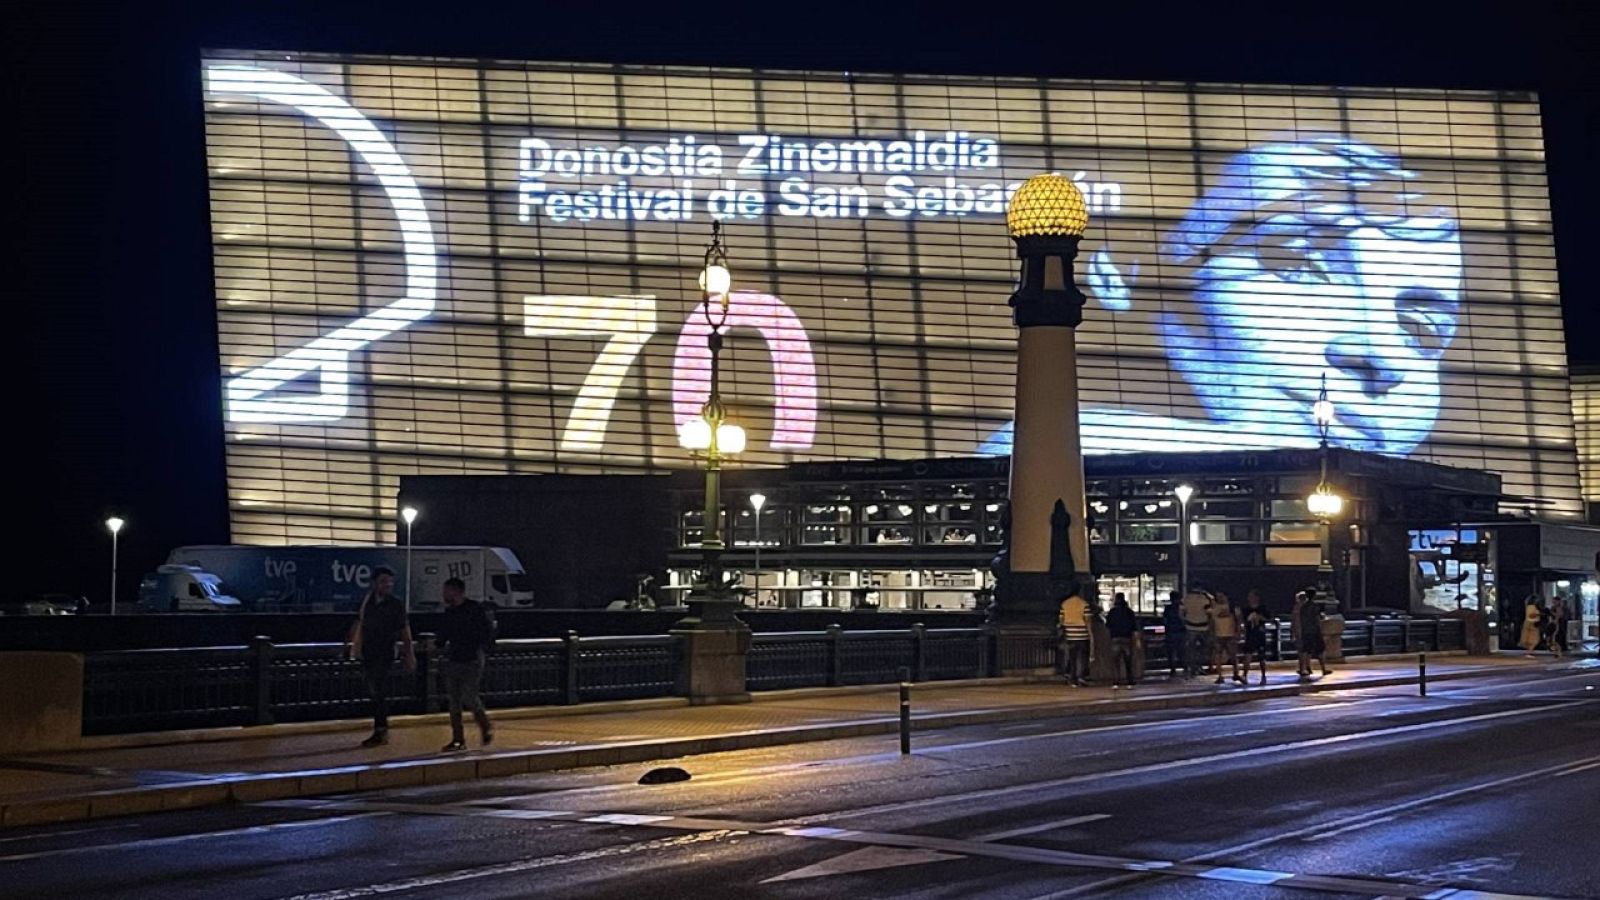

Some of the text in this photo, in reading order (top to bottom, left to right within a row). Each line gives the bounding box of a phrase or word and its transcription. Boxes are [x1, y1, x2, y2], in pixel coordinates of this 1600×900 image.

[519, 132, 998, 178] Donostia Zinemaldia
[518, 180, 693, 222] Festival
[707, 180, 766, 219] de
[778, 179, 868, 217] San
[523, 290, 818, 451] 70
[265, 556, 297, 580] tve
[331, 559, 371, 588] tve
[447, 560, 471, 579] HD
